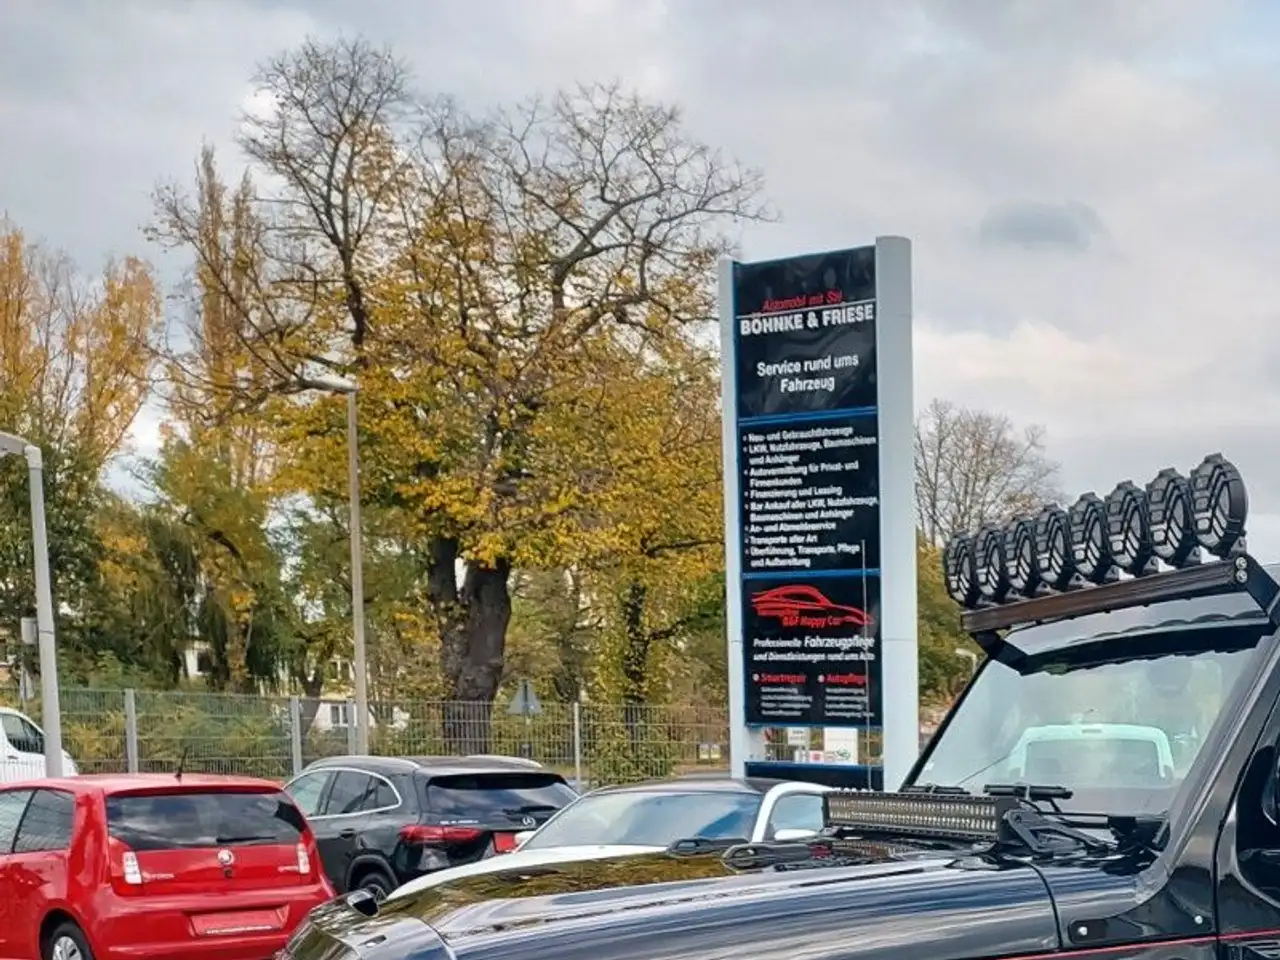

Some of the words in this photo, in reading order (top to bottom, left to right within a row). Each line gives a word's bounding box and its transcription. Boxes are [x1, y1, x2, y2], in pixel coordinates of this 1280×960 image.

[806, 311, 819, 329] &
[822, 303, 874, 326] FRIESE
[757, 360, 801, 376] Service
[803, 355, 832, 371] rund
[833, 354, 859, 367] ums
[780, 377, 835, 393] Fahrzeug
[766, 432, 781, 440] und
[749, 456, 764, 465] und
[844, 460, 859, 470] und
[799, 487, 812, 496] und
[814, 485, 842, 496] Leasing
[805, 511, 818, 519] und
[763, 523, 778, 532] und
[751, 558, 764, 567] und
[804, 635, 875, 651] Fahrzeugpflege
